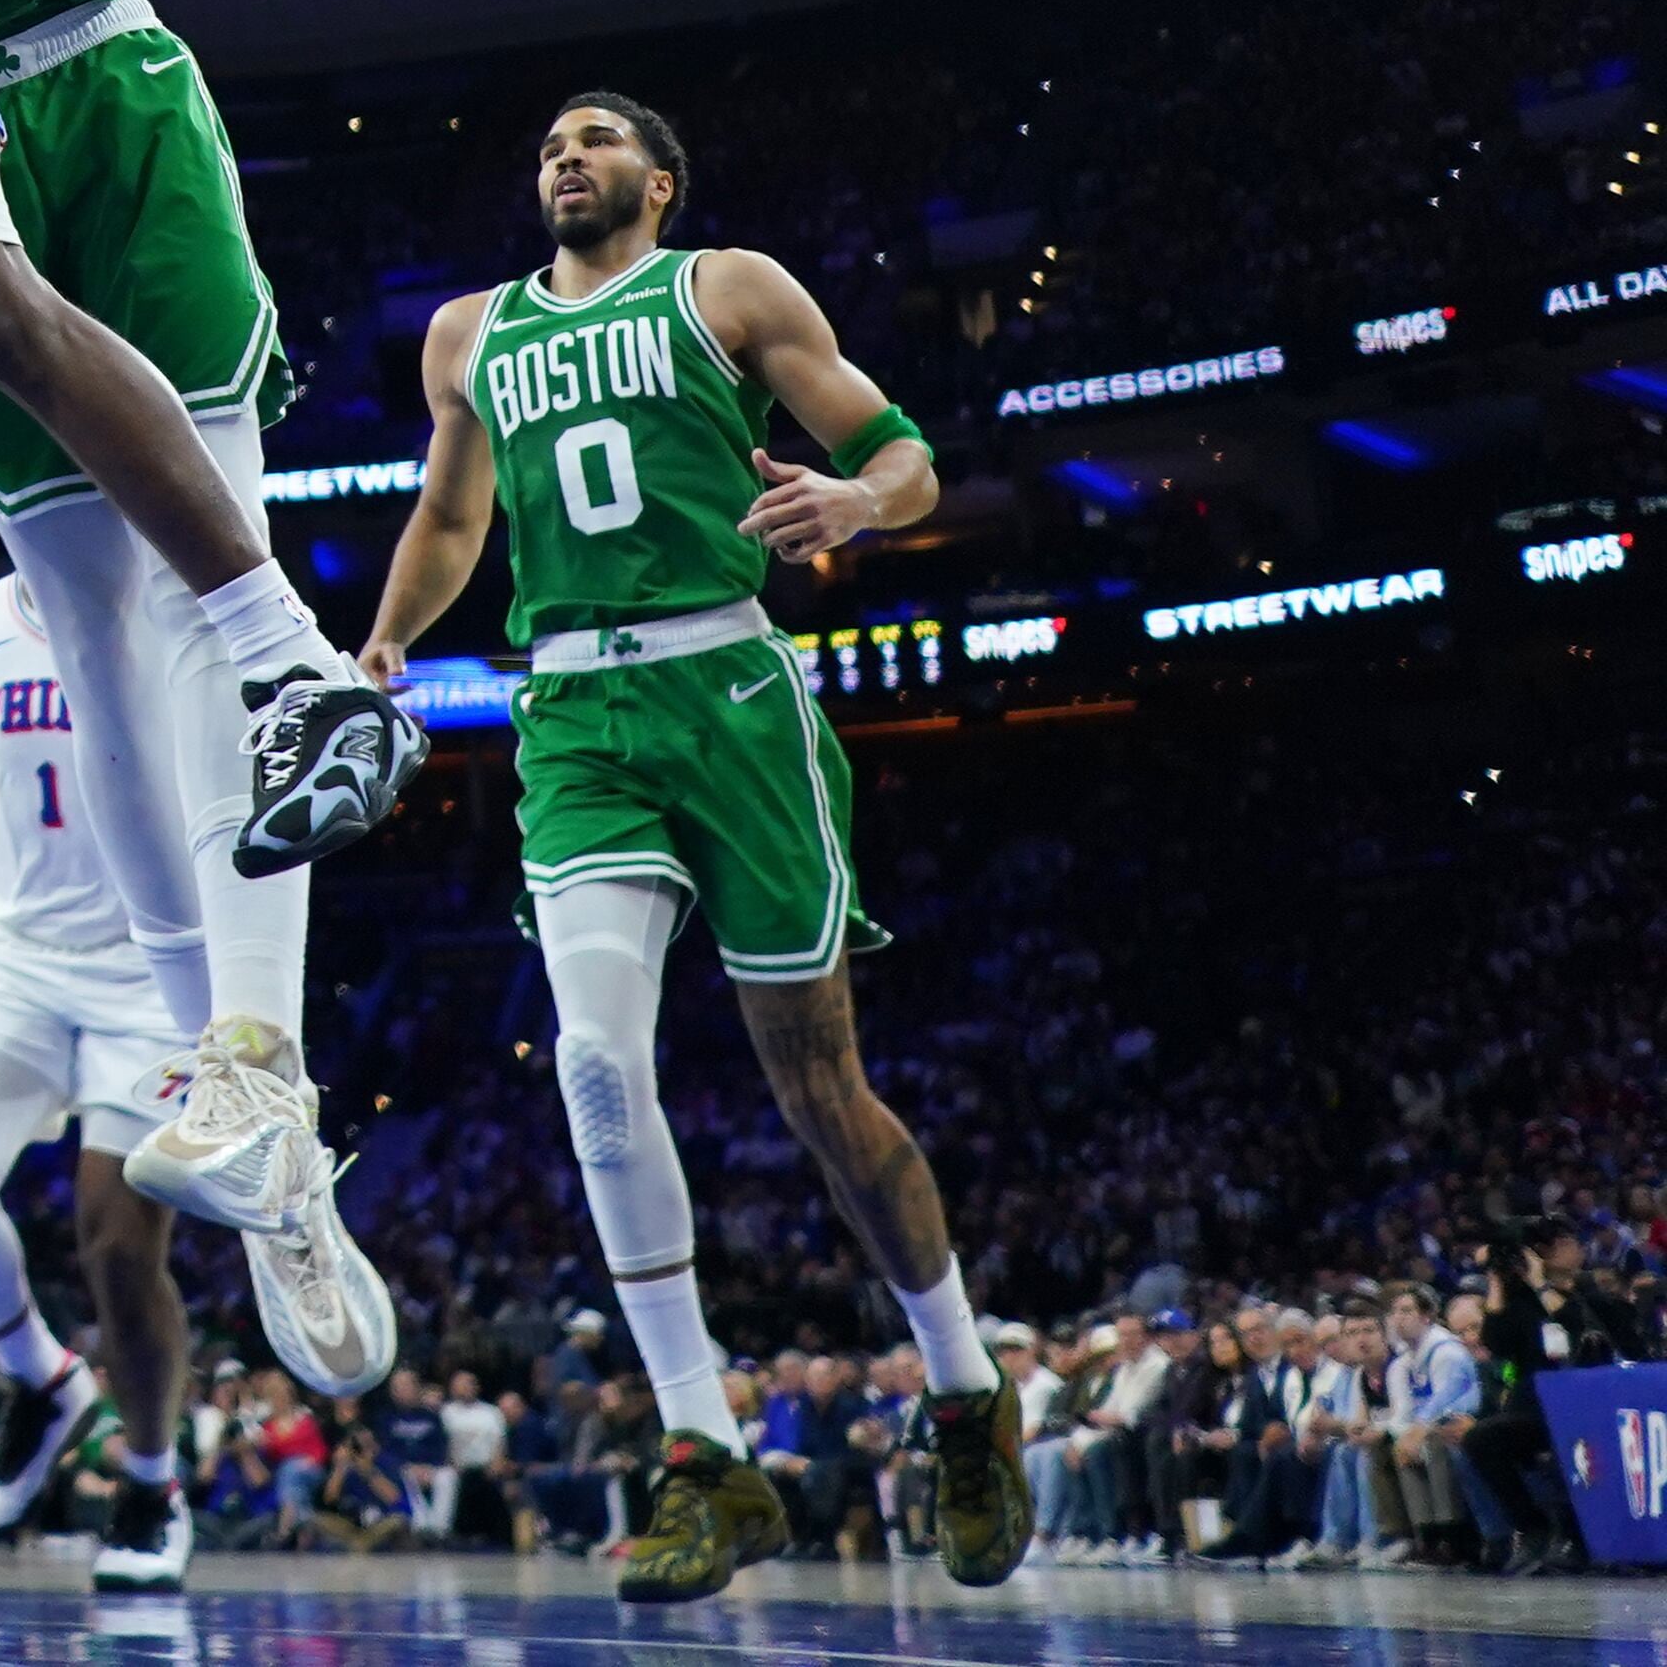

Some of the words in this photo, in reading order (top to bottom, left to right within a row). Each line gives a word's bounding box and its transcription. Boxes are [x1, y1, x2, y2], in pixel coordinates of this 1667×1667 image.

[613, 284, 668, 308] Amica
[1546, 281, 1609, 316] ALL
[1355, 308, 1447, 356] snipes
[486, 316, 677, 439] BOSTON
[997, 346, 1285, 419] ACCESSORIES
[261, 459, 427, 501] REETWE
[555, 416, 643, 536] 0
[1522, 534, 1626, 583] snipes
[1143, 568, 1446, 640] STREETWEAR
[963, 615, 1058, 662] snipes
[34, 761, 64, 829] 1
